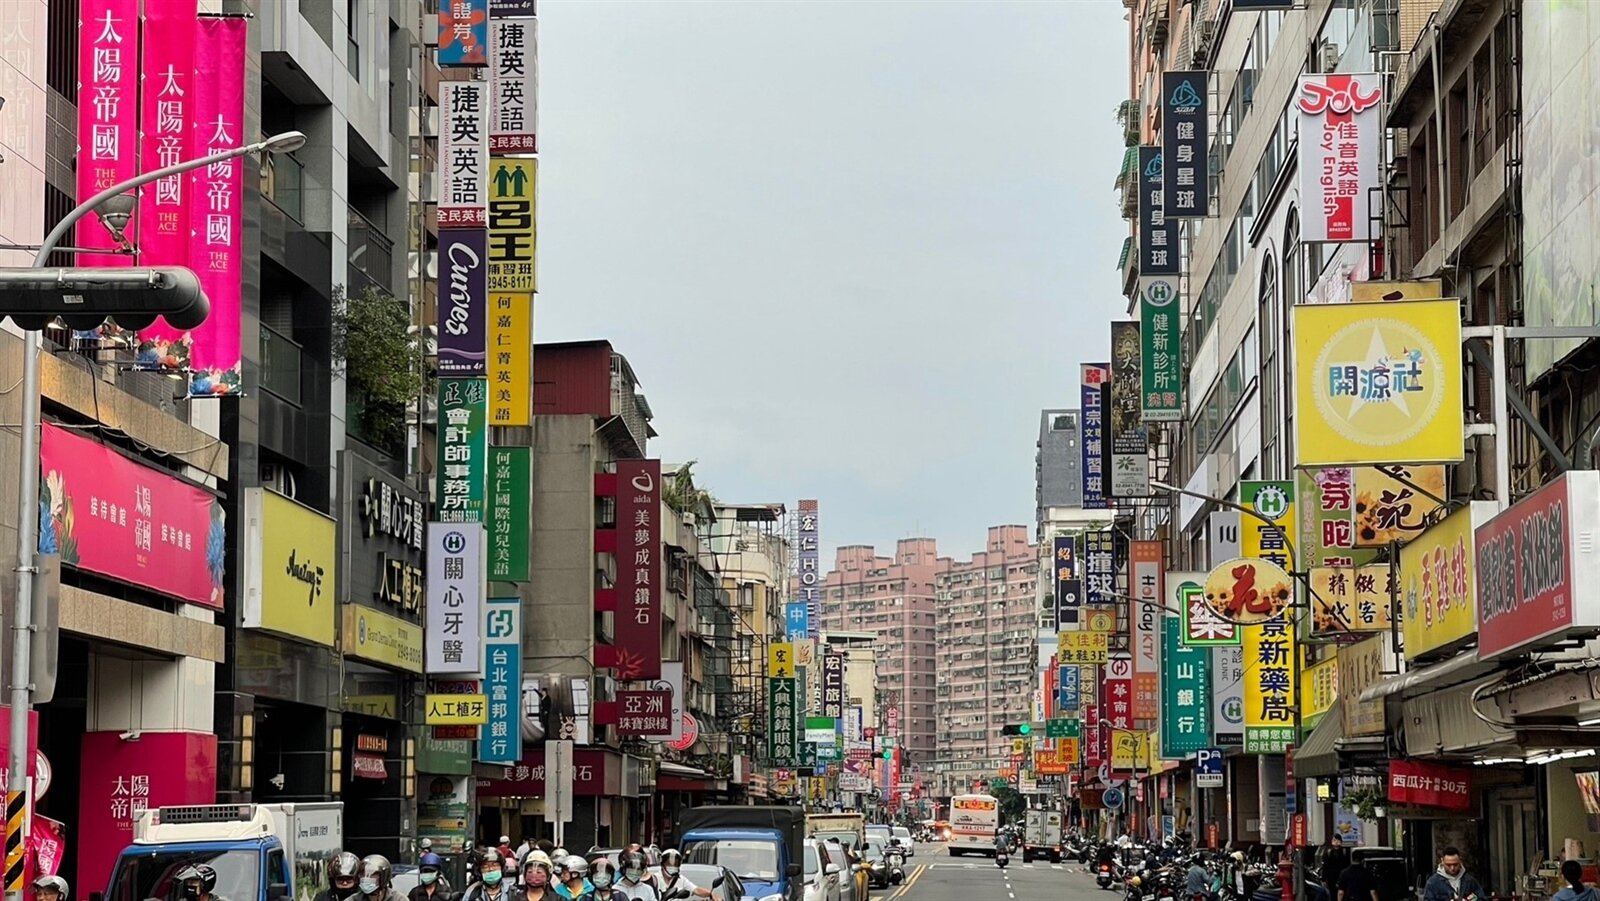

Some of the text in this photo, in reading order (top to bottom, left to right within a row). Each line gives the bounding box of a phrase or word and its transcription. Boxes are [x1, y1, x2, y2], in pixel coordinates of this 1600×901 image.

[454, 2, 471, 40] 證券
[92, 10, 122, 160] 太陽帝國
[499, 24, 524, 131] 捷英英語
[156, 64, 184, 206] 太陽帝國
[452, 85, 479, 203] 捷英英語
[489, 137, 533, 148] 全民英檢
[94, 169, 116, 179] THE
[1176, 122, 1194, 208] 健身星球
[1320, 123, 1337, 215] Joy English
[1337, 123, 1359, 196] 佳音英語
[94, 179, 116, 189] ACE
[207, 115, 234, 246] 太陽帝國
[158, 213, 178, 222] THE
[158, 222, 178, 232] ACE
[437, 210, 486, 222] 全民英檢
[489, 201, 531, 261] 呂王
[1151, 190, 1167, 266] 健身星球
[208, 252, 229, 261] THE
[208, 261, 228, 270] ACE
[445, 242, 479, 335] Curves
[488, 276, 532, 289] 2945-8117
[473, 362, 484, 370] 4F
[495, 296, 511, 420] 何嘉仁菁英美語
[1153, 313, 1170, 389] 健新診所
[443, 380, 485, 405] 正佳
[1120, 351, 1139, 413] 大師堂
[1328, 361, 1424, 400] 開源社
[1147, 392, 1177, 407] 洗腎
[443, 408, 472, 509] 會計師事務所
[1086, 439, 1102, 492] 補習班
[90, 496, 126, 527] 接待會館
[135, 484, 151, 519] 太陽
[381, 481, 423, 550] 關心牙醫
[633, 495, 651, 504] aida
[135, 518, 151, 552] 帝國
[161, 523, 192, 551] 接待會館
[801, 515, 816, 551] 宏仁
[379, 552, 422, 615] 人工植牙
[634, 509, 650, 625] 美夢成真鑽石
[1087, 552, 1113, 594] 撞球
[1232, 563, 1273, 617] 花
[443, 557, 464, 663] 關心牙醫
[1138, 575, 1156, 661] Holiday KTV
[1257, 526, 1290, 722] 富景新藥局
[491, 649, 508, 755] 台北富邦銀行
[826, 656, 840, 717] 宏仁旅館
[1066, 667, 1077, 700] NOKIA
[428, 701, 484, 718] 人工植牙
[625, 696, 664, 713] 亞洲
[619, 717, 669, 730] 珠寶銀樓
[503, 765, 593, 781] 美夢成石
[1198, 750, 1210, 767] P
[111, 775, 149, 796] 太陽
[1393, 774, 1433, 790] 西瓜汁
[1441, 779, 1468, 795] 30元
[110, 797, 149, 819] 帝國
